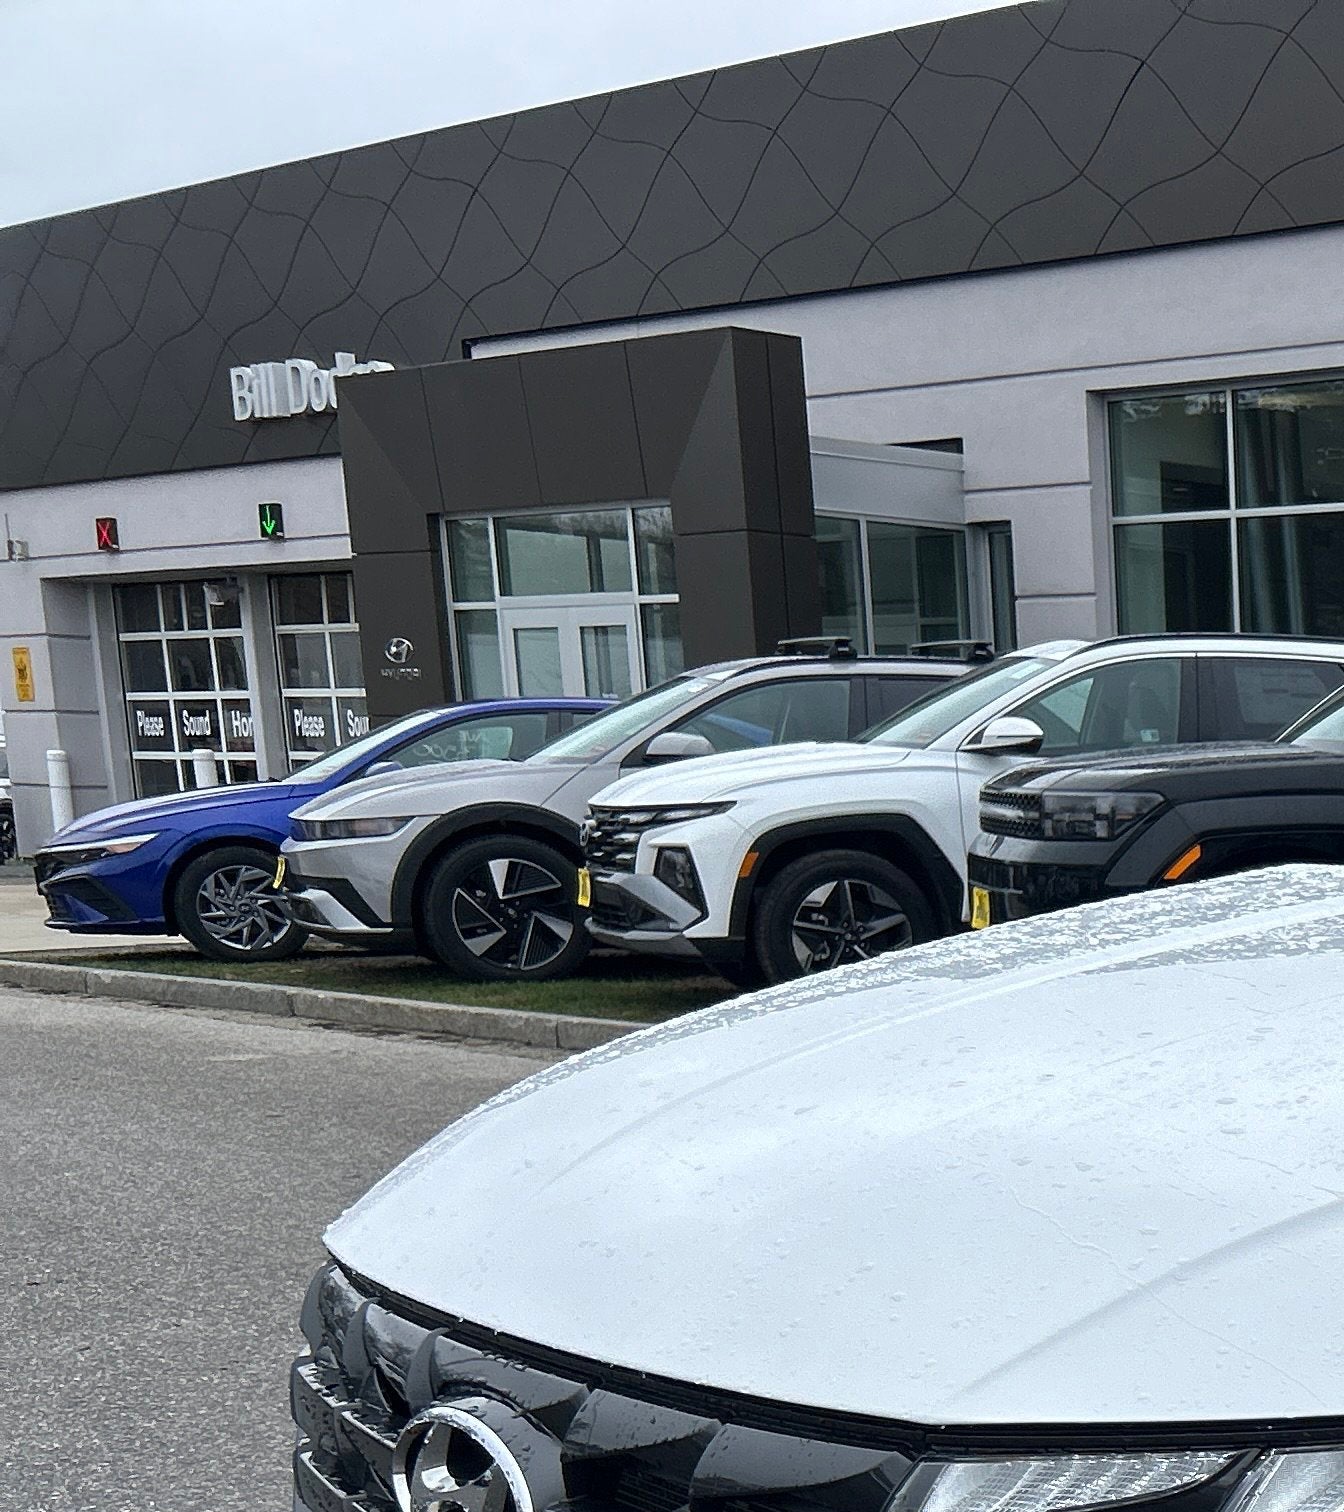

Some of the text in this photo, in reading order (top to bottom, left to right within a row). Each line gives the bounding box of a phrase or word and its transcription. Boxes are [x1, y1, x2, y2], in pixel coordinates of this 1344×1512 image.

[230, 364, 290, 421] Bill
[136, 709, 254, 737] Please Sound Hor
[293, 708, 325, 737] Please
